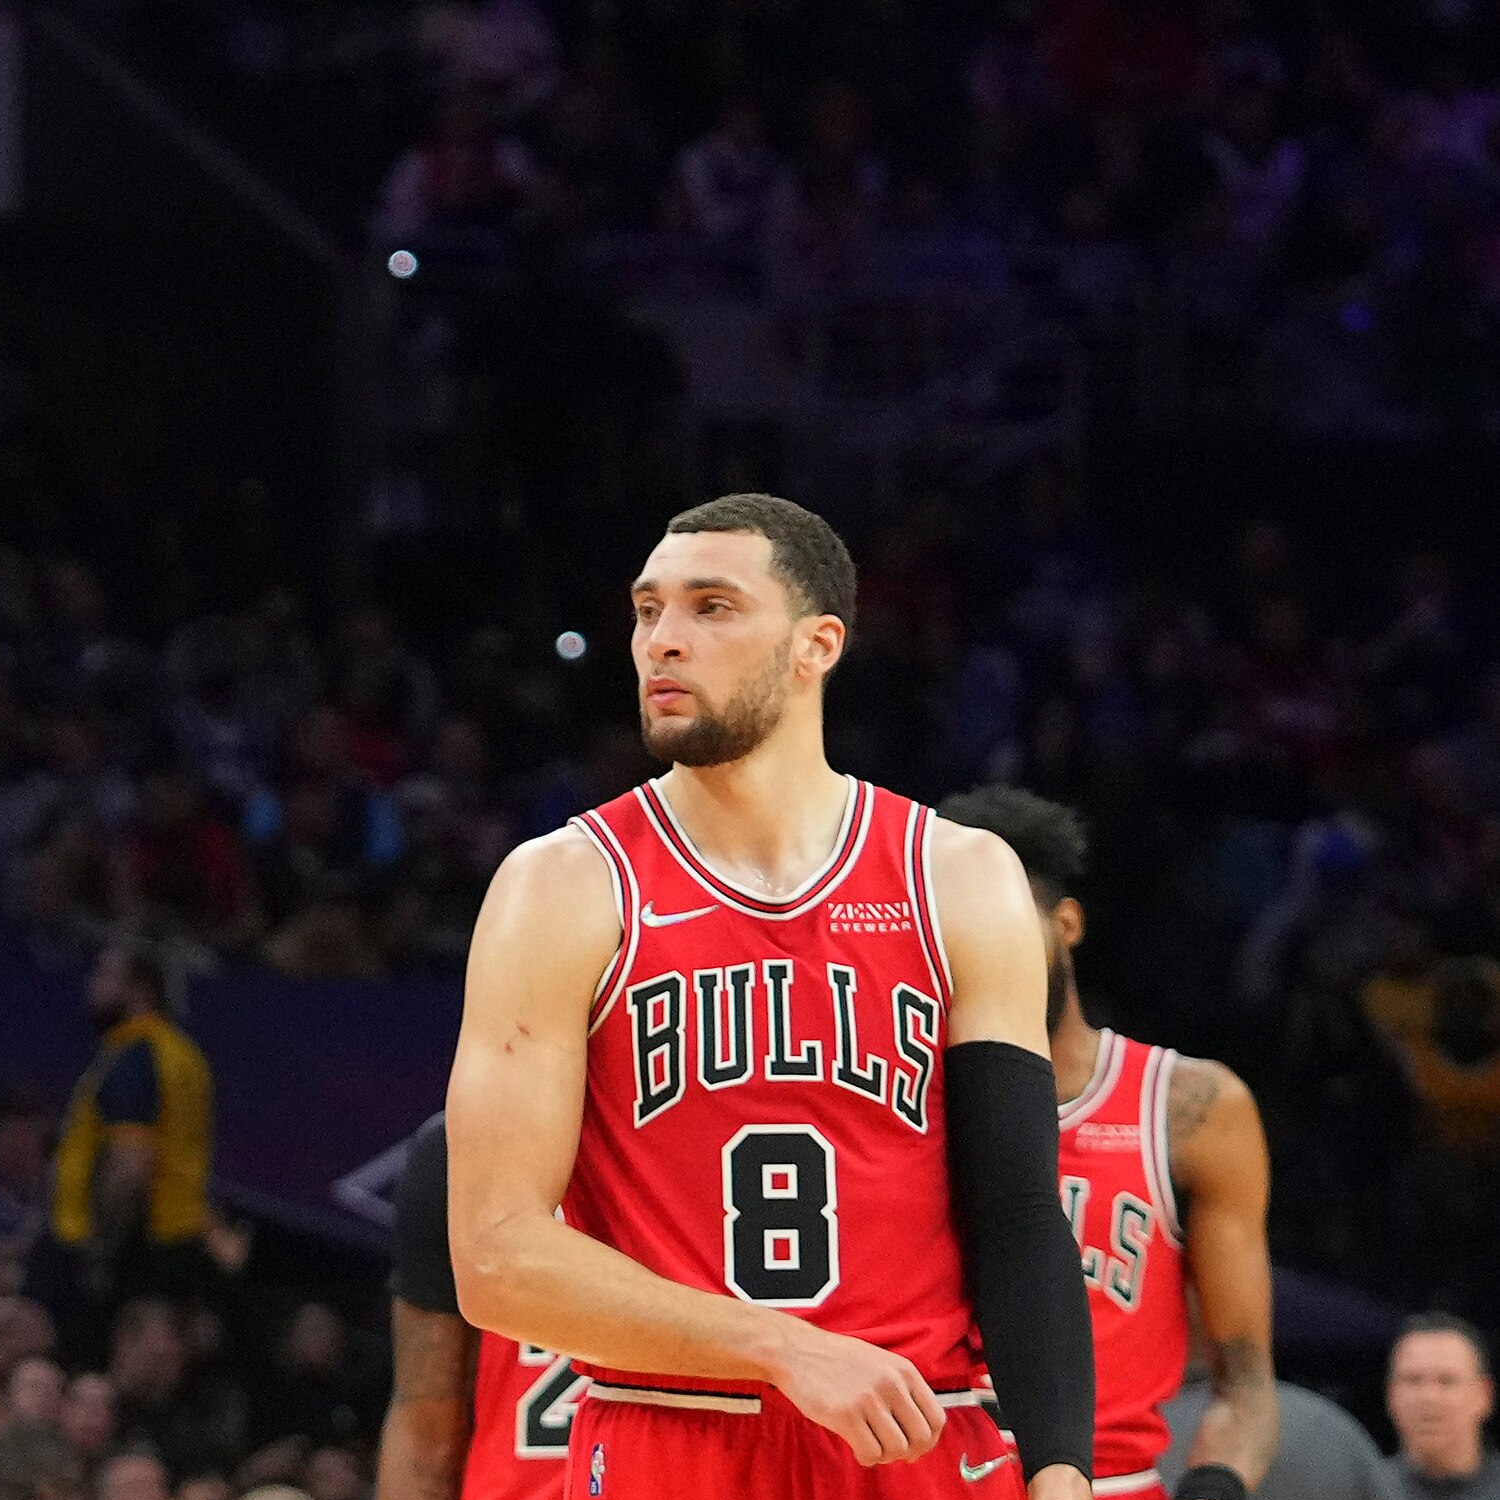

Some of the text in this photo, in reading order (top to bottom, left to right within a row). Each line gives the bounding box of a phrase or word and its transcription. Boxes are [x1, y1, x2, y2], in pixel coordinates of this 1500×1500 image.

[828, 901, 910, 920] ZENNI
[830, 920, 912, 933] EYEWEAR
[626, 957, 940, 1134] BULLS
[722, 1123, 839, 1308] 8
